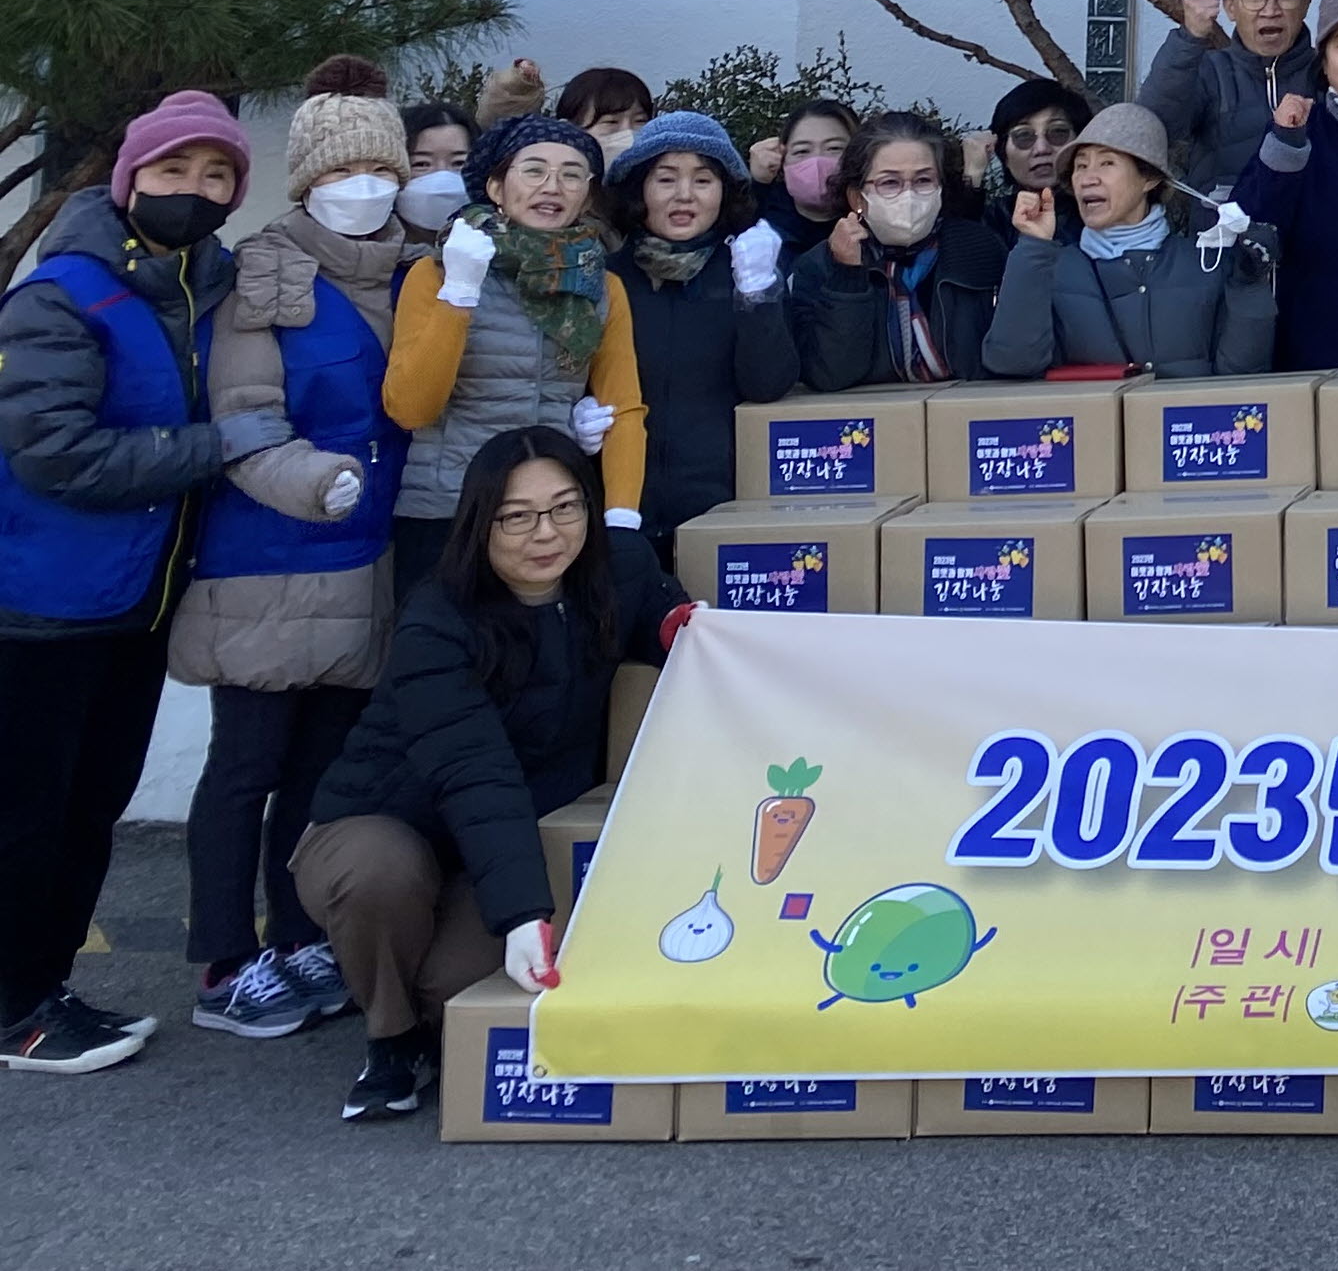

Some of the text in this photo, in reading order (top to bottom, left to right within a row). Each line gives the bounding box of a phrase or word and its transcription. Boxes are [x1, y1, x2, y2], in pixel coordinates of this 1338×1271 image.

[1173, 444, 1240, 467] 김장나눔
[779, 459, 847, 481] 김장나눔
[979, 458, 1046, 480] 김장나눔
[728, 584, 798, 606] 김장나눔
[934, 579, 1004, 601] 김장나눔
[1133, 576, 1204, 600] 김장나눔
[496, 1079, 579, 1106] 김장나눔
